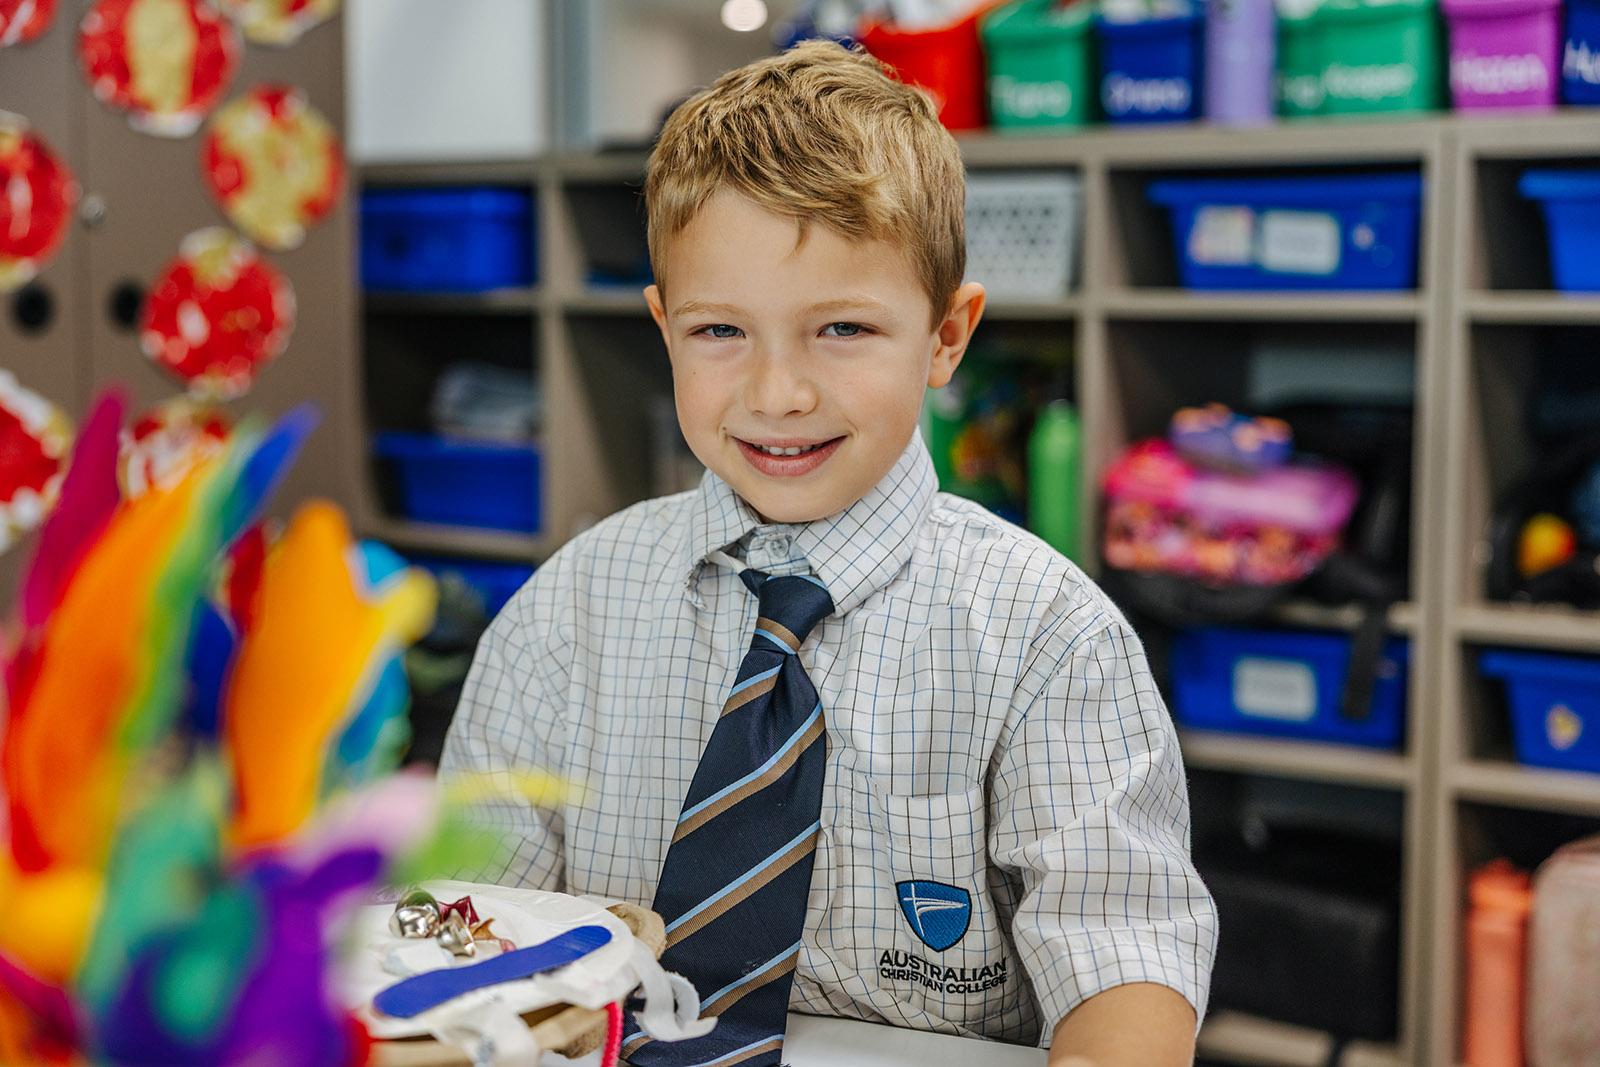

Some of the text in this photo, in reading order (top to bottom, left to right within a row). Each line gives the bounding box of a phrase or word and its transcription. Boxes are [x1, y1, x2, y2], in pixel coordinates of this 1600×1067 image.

[880, 950, 1007, 982] AUSTRALIAN
[880, 968, 1007, 994] CHRISTIAN COLLEGE
